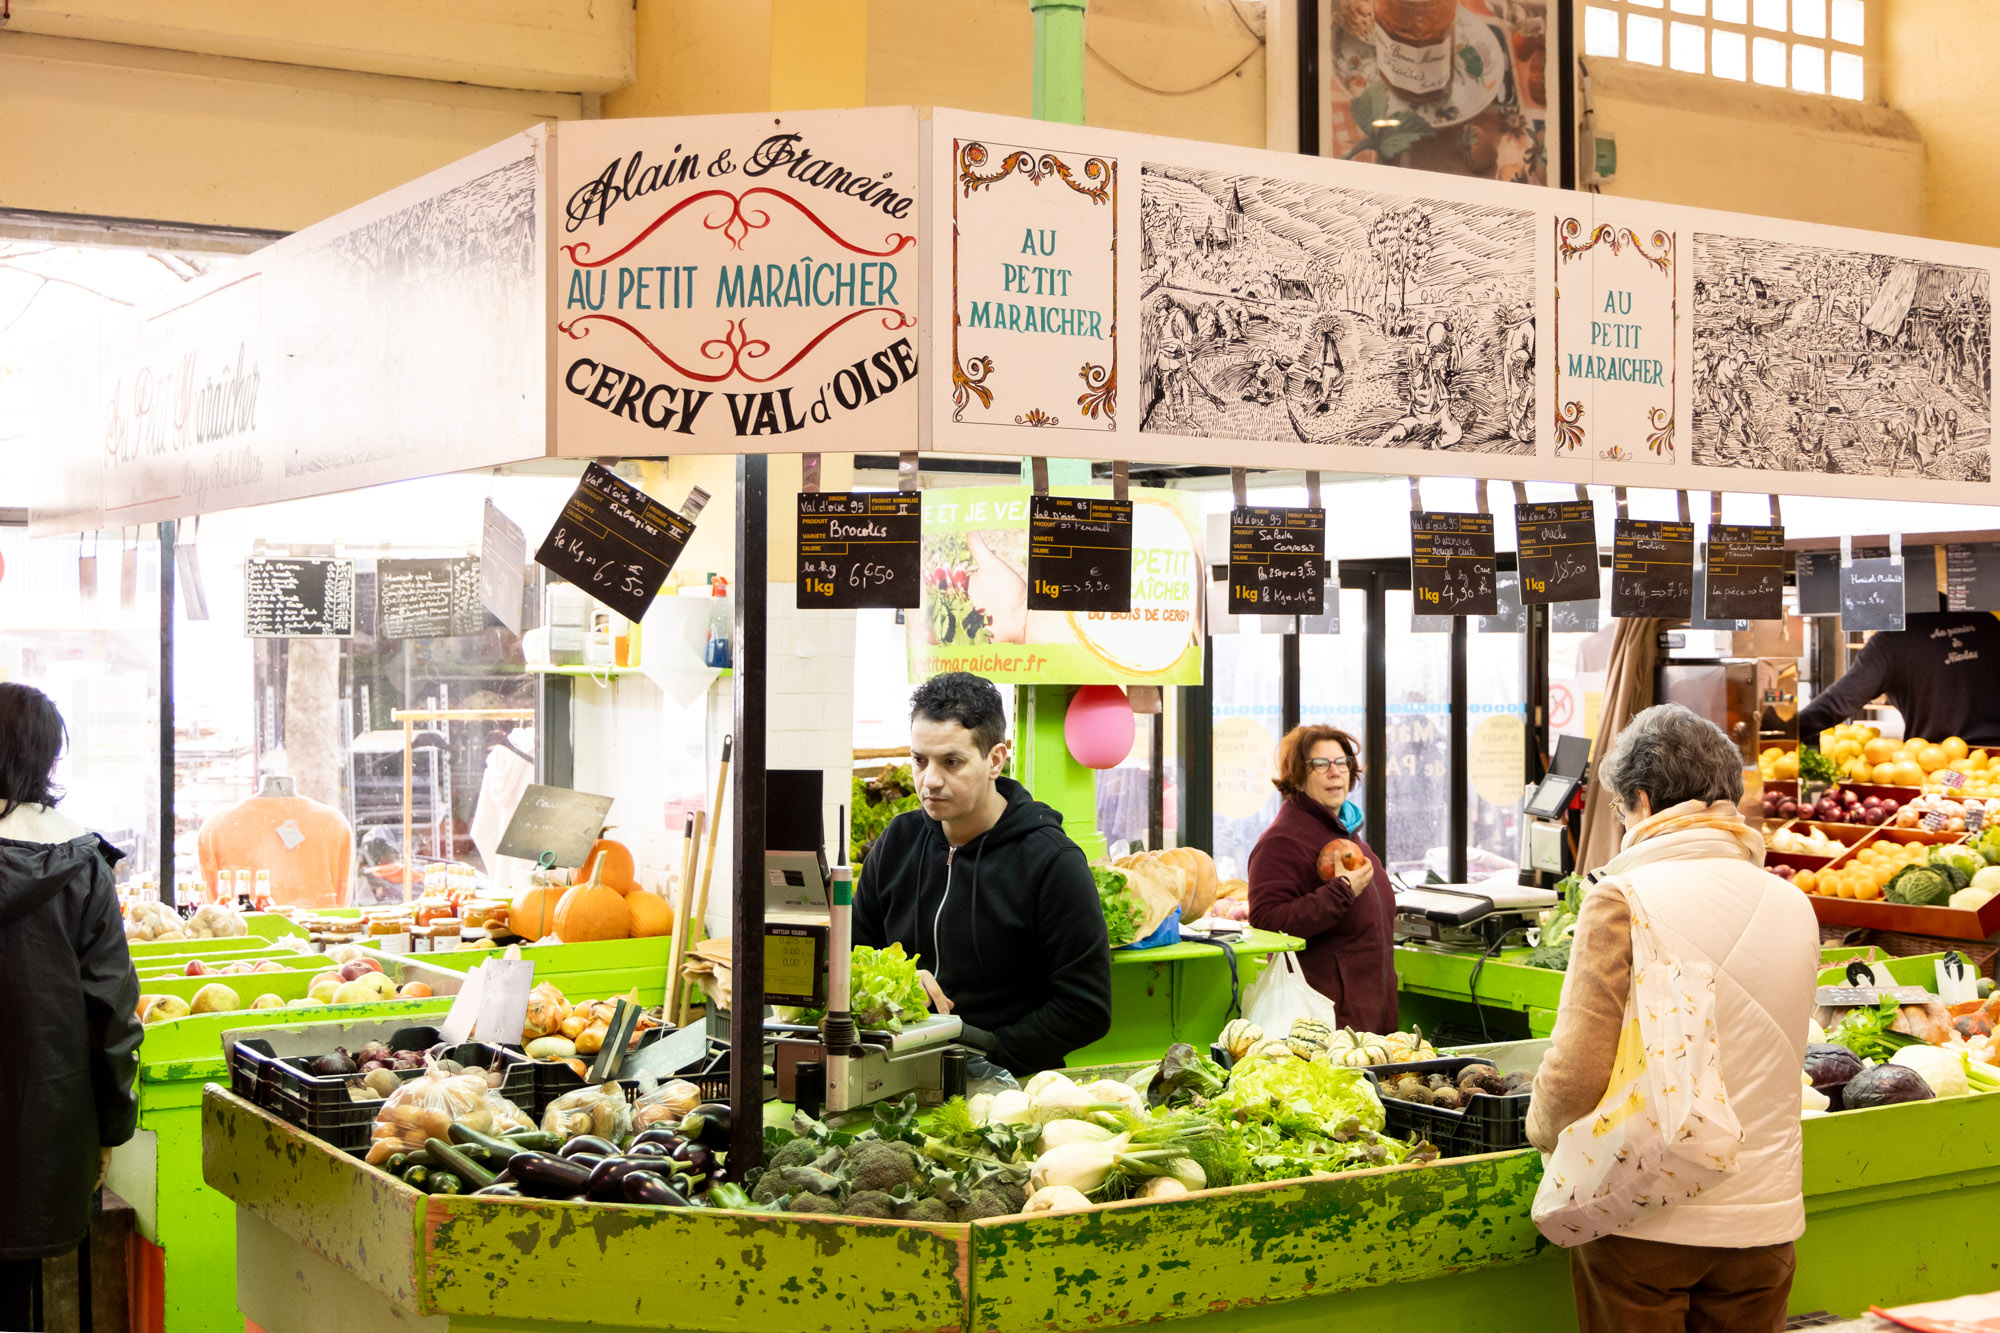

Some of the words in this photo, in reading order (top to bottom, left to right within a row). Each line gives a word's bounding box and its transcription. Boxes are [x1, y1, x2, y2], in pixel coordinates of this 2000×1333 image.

[565, 143, 701, 233] Alain
[707, 148, 737, 178] &
[743, 132, 913, 220] Francine
[1020, 228, 1057, 256] AU
[567, 268, 607, 311] AU
[617, 266, 698, 310] PETIT
[715, 255, 899, 308] MARAÎCHER
[1001, 263, 1072, 297] PETIT
[1603, 290, 1632, 315] AU
[967, 301, 1105, 340] MARAICHER
[1590, 321, 1643, 349] PETIT
[1567, 353, 1665, 387] MARAICHER
[565, 358, 714, 435] CERGY
[722, 387, 807, 436] VAL
[580, 486, 603, 502] PRODUIT
[585, 472, 601, 488] Val
[801, 501, 816, 513] Val
[850, 500, 864, 514] 95
[830, 519, 887, 538] Brocolis
[802, 561, 816, 573] le
[818, 560, 837, 579] kg
[1144, 608, 1159, 621] DE
[1162, 608, 1189, 622] CERGY
